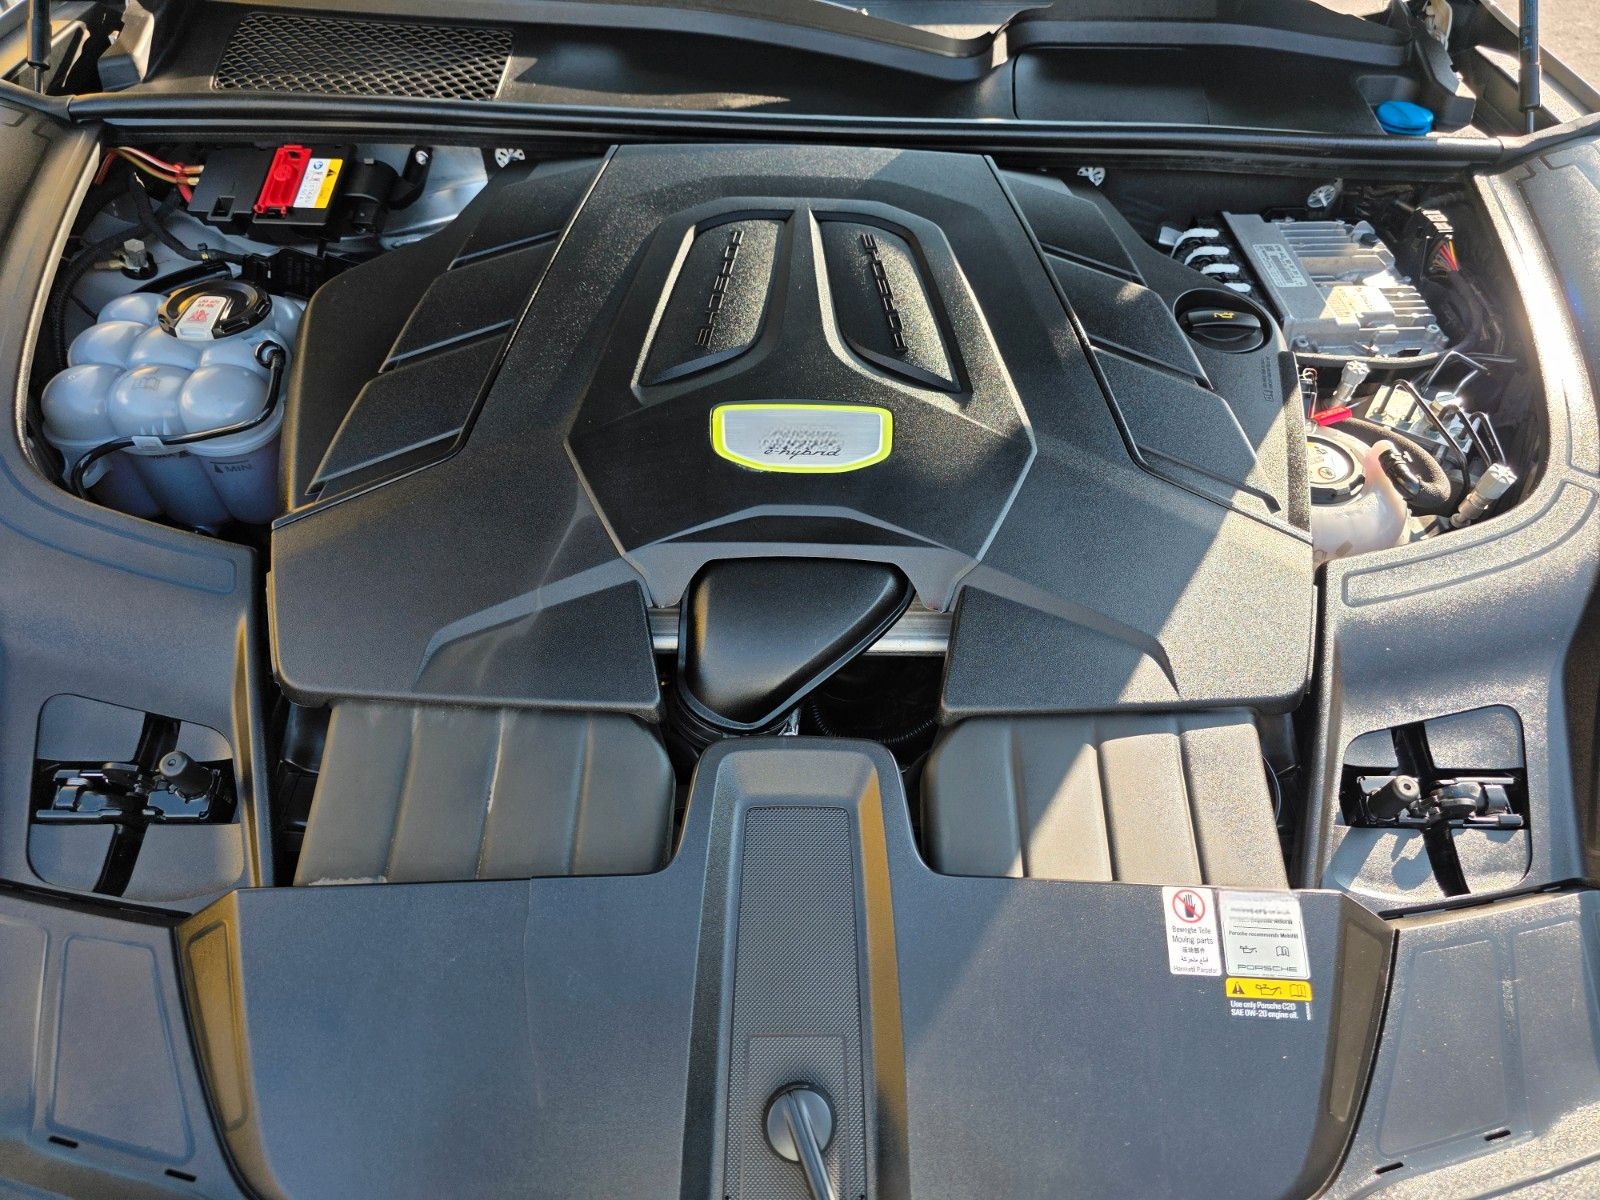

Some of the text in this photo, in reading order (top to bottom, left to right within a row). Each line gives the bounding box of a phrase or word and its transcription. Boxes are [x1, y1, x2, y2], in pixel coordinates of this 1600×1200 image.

[694, 230, 745, 346] PORSCHE
[859, 232, 909, 353] PORSCHE
[1172, 935, 1214, 945] Moving parts
[1237, 964, 1298, 973] PORSCHE
[1230, 1000, 1242, 1008] Use
[1243, 1001, 1256, 1009] only
[1256, 1001, 1281, 1010] Porsche
[1230, 1008, 1244, 1016] SAE
[1267, 1011, 1289, 1020] engine
